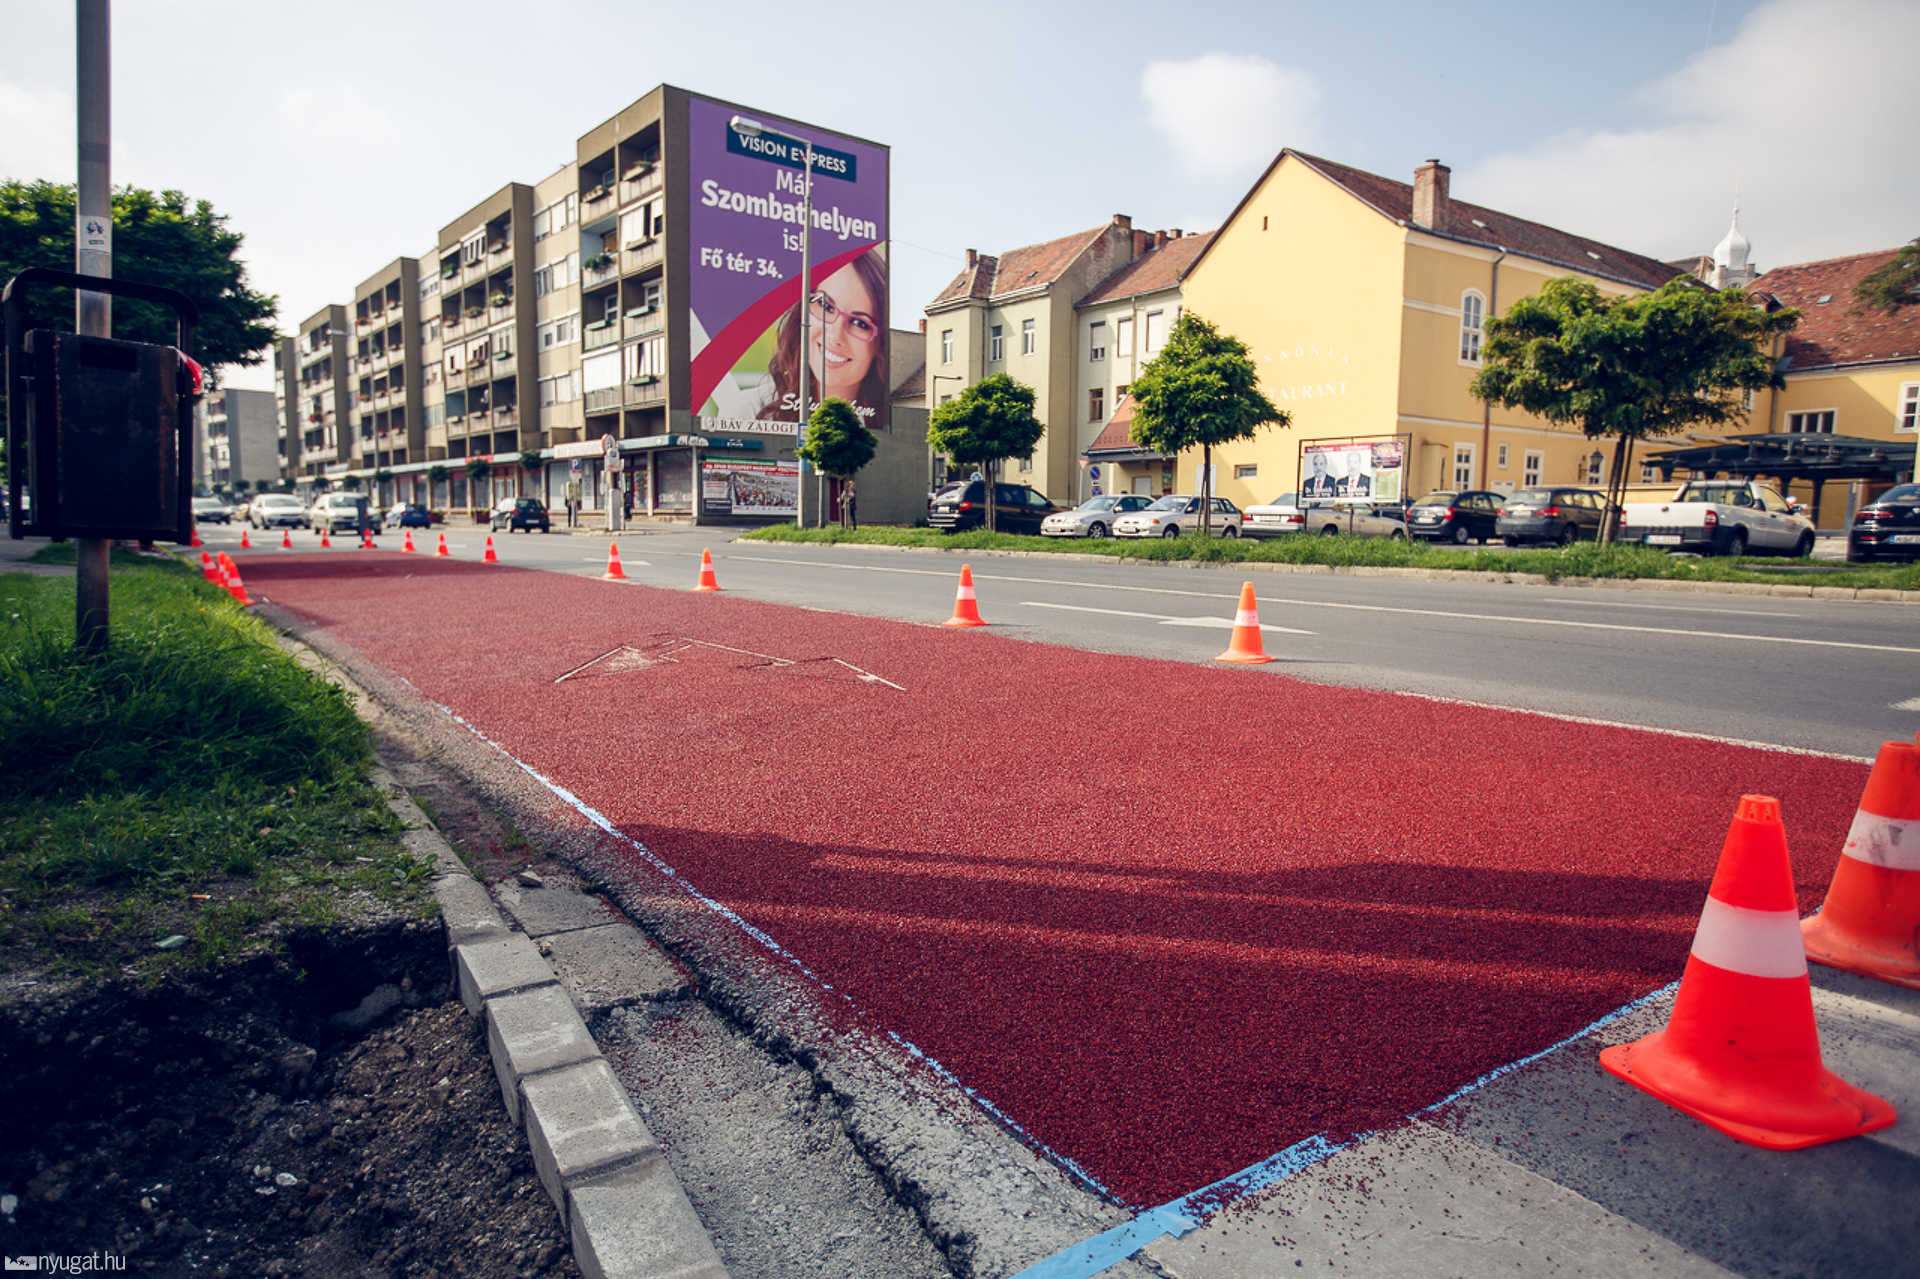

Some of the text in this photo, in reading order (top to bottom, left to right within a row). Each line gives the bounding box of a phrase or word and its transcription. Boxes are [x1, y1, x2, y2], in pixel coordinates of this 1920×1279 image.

[739, 134, 787, 158] VISION
[701, 179, 877, 241] Szombathelyen
[783, 228, 804, 252] is!
[700, 247, 784, 280] Fő tér 34.
